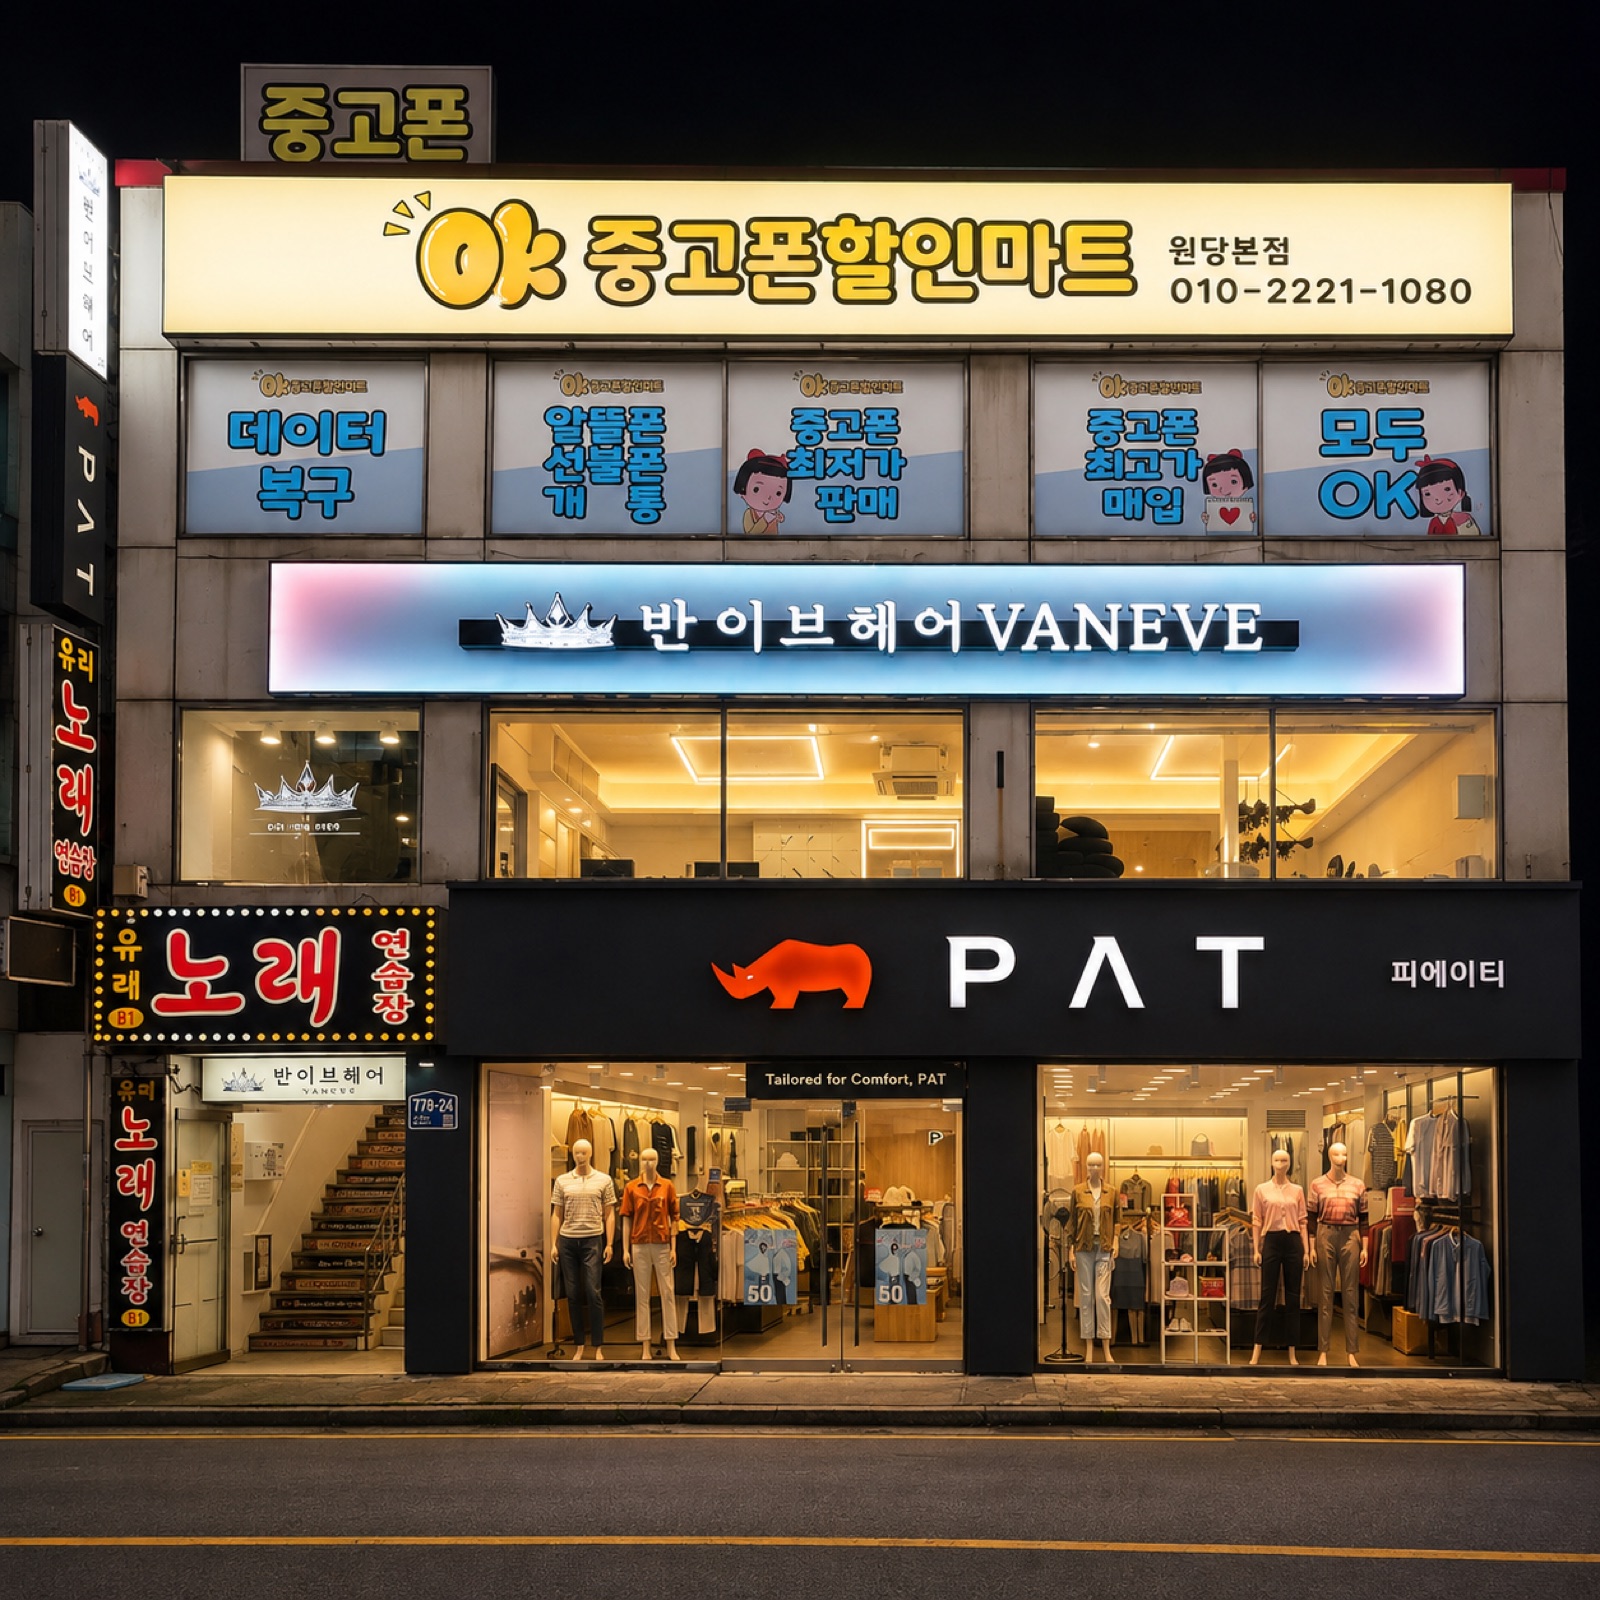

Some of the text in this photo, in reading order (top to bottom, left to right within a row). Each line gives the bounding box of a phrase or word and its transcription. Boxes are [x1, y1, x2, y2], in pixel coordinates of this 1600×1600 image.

[259, 83, 473, 162] 중고폰
[584, 213, 1138, 306] 중고폰할인마트
[1169, 236, 1290, 266] 원당본점
[1170, 277, 1473, 304] 010-2221-1080
[228, 409, 387, 456] 데이터
[543, 405, 667, 445] 알뜰폰
[789, 407, 901, 445] 중고폰
[1086, 408, 1199, 446] 중고폰
[1318, 408, 1427, 463] 모두
[542, 444, 667, 485] 선불폰
[785, 445, 907, 480] 최저가
[1084, 447, 1204, 482] 최고가
[257, 465, 355, 520] 복구
[815, 484, 899, 523] 판매
[1102, 486, 1184, 524] 매입
[1317, 469, 1420, 520] OK
[976, 601, 1266, 652] VANEVE
[55, 679, 97, 836] 노래
[112, 928, 143, 1001] 유래
[150, 926, 342, 1027] 노래
[946, 936, 1265, 1009] PAT
[1391, 960, 1504, 988] 피에이티
[116, 1011, 135, 1026] B1
[273, 1065, 384, 1086] 반이브헤어
[765, 1073, 947, 1087] Tailored for Comfort, PAT
[115, 1105, 158, 1211] 노래
[748, 1285, 773, 1304] 50
[878, 1285, 904, 1304] 50
[128, 1312, 143, 1325] B1
